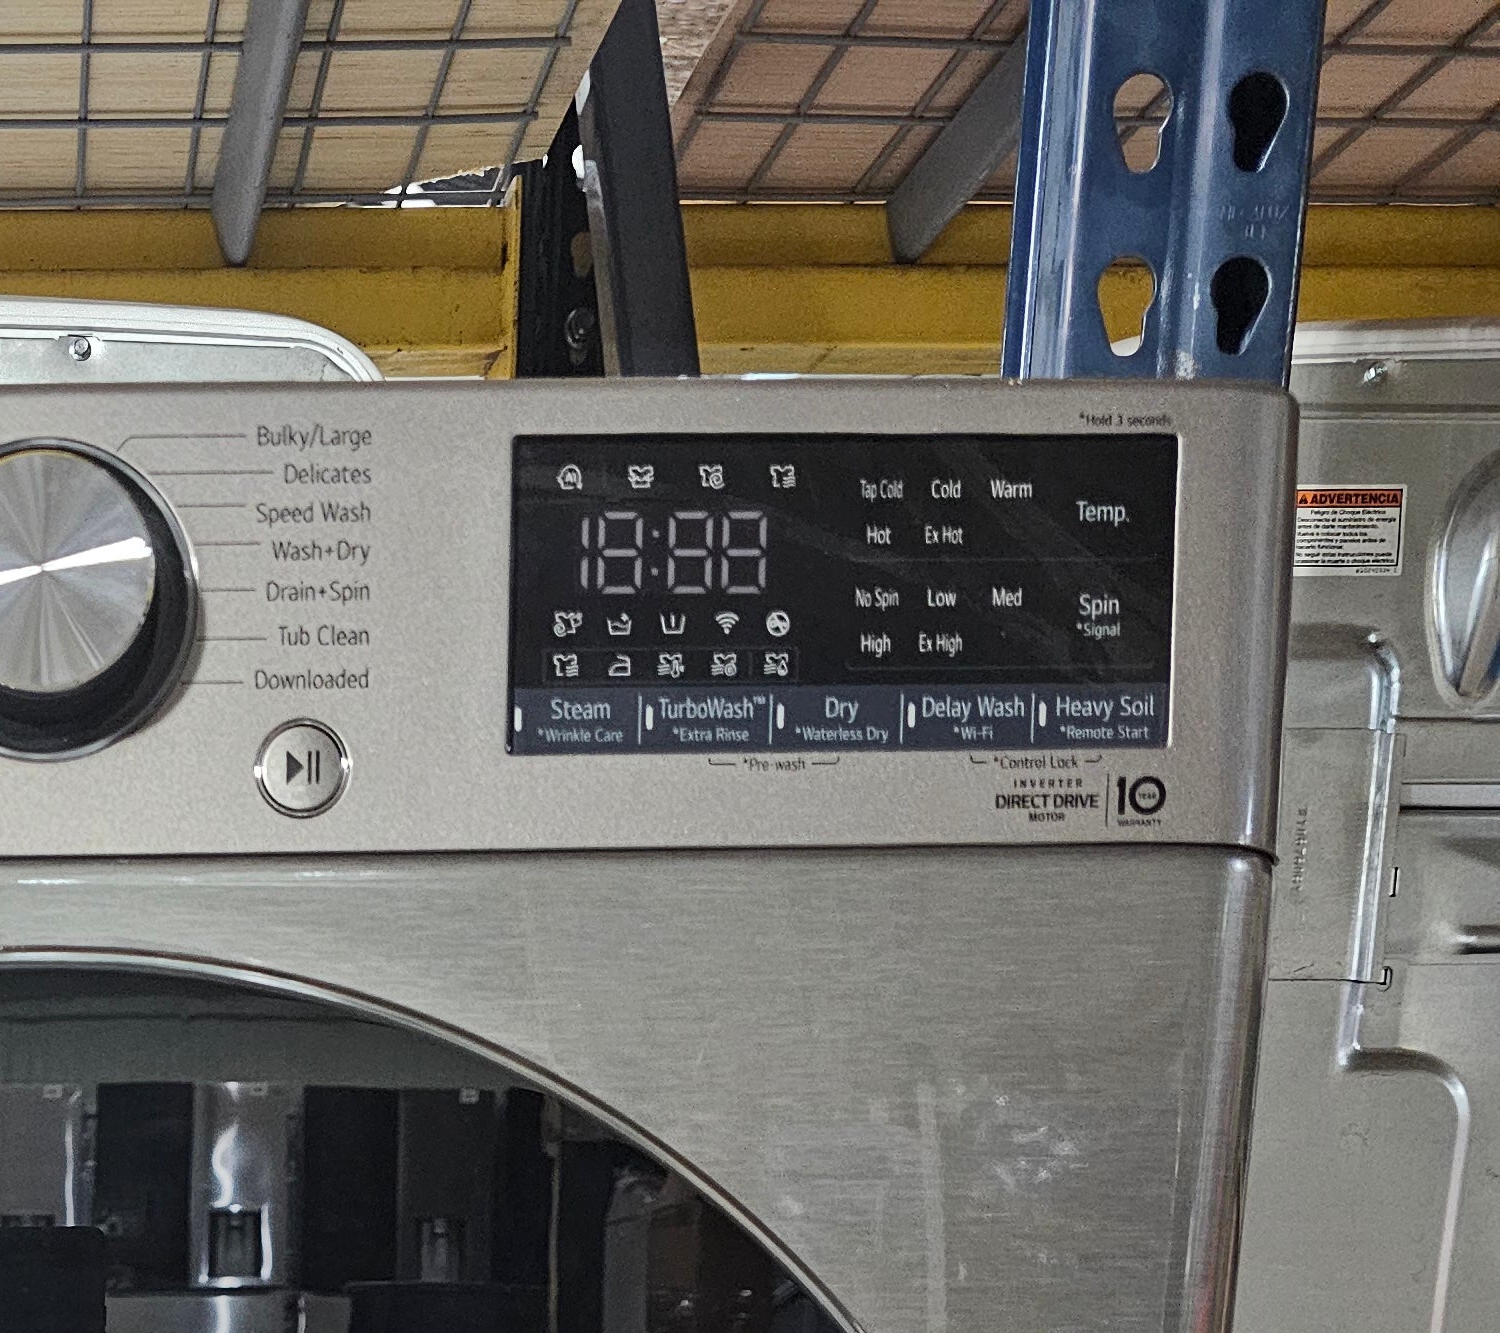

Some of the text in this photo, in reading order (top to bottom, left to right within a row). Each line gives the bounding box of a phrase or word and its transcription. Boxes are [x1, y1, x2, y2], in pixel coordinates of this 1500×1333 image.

[257, 423, 372, 451] Bulky/Large
[283, 463, 372, 485] Delicates
[860, 478, 904, 502] Tap Cold
[931, 479, 961, 499] Cold
[990, 479, 1032, 500] Warm
[1309, 493, 1399, 505] ADVERTENCIA
[256, 501, 371, 529] Speed Wash
[1076, 500, 1130, 527] Temp.
[866, 524, 891, 545] Hot
[925, 524, 963, 545] Ex Hot
[272, 540, 370, 566] Wash+Dry
[266, 580, 370, 606] Drain+Spin
[855, 586, 899, 611] No Spin
[927, 586, 957, 607] Low
[992, 586, 1022, 607] Med
[1079, 594, 1119, 620] Spin
[278, 624, 370, 647] Tub Clean
[860, 632, 892, 657] High
[918, 631, 963, 657] Ex High
[254, 668, 369, 690] Downloaded
[551, 697, 611, 720] Steam
[825, 695, 860, 724] Dry
[922, 693, 1025, 723] Delay Wash
[1056, 694, 1155, 723] Heavy Soil
[595, 727, 624, 743] Care
[716, 727, 749, 742] Rinse
[866, 726, 889, 744] Dry
[1117, 725, 1149, 740] Start
[1050, 755, 1079, 770] Lock
[1013, 777, 1083, 789] INVERTER
[994, 793, 1099, 809] DIRECT DRIVE
[1116, 775, 1167, 816] 10
[1027, 811, 1066, 823] MOTOR
[1116, 818, 1163, 828] WARRANTY
